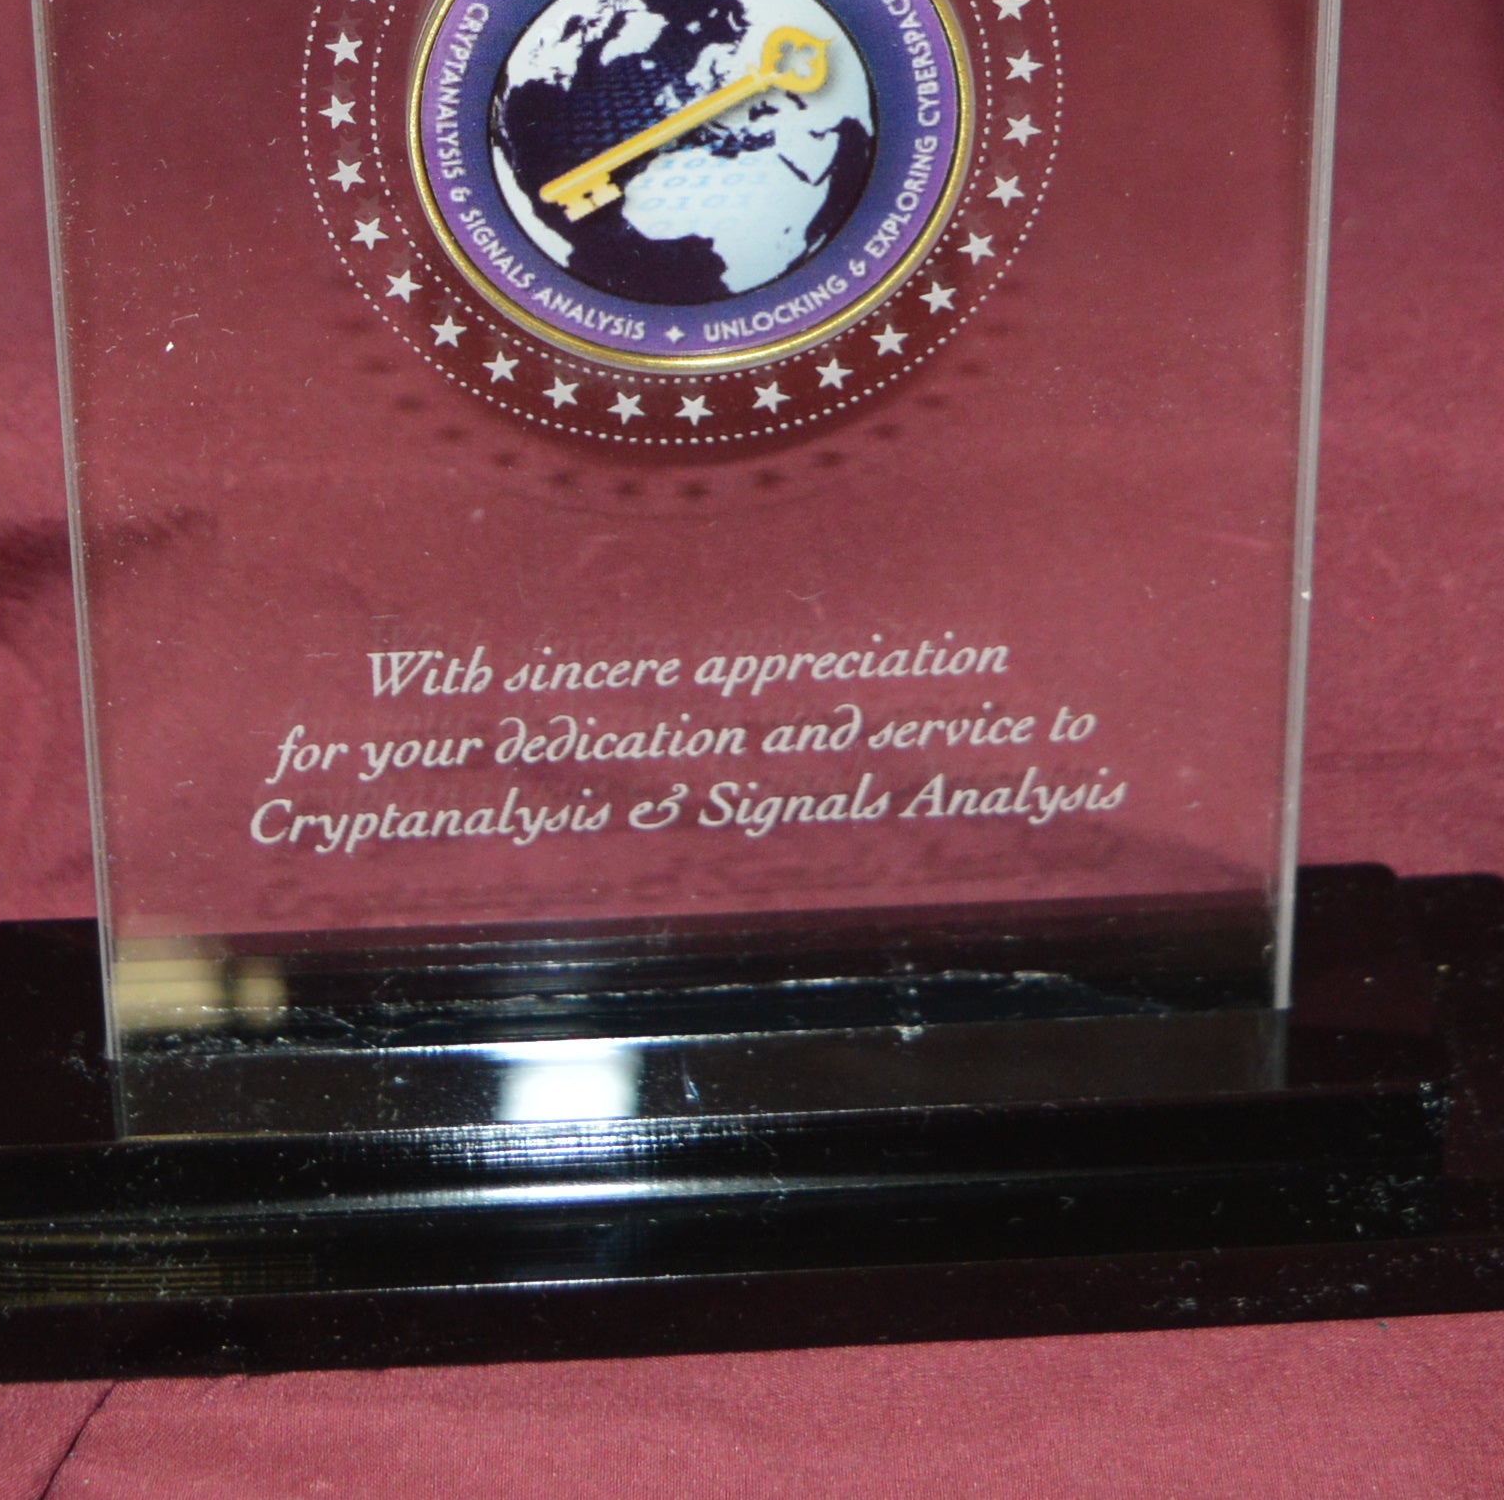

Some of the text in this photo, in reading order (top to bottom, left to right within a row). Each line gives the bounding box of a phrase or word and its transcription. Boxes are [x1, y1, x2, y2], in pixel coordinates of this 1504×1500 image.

[435, 2, 646, 341] CRYPTANALYSIS & SIGNALS ANALYSIS
[703, 273, 849, 342] UNLOCKING
[849, 258, 867, 278] &
[863, 135, 938, 259] EXPLORING
[366, 630, 1011, 698] With sincere appreciation
[264, 700, 1098, 785] for your dedication and service to
[249, 765, 1128, 854] Cryptanalysis & Signals Analysis
